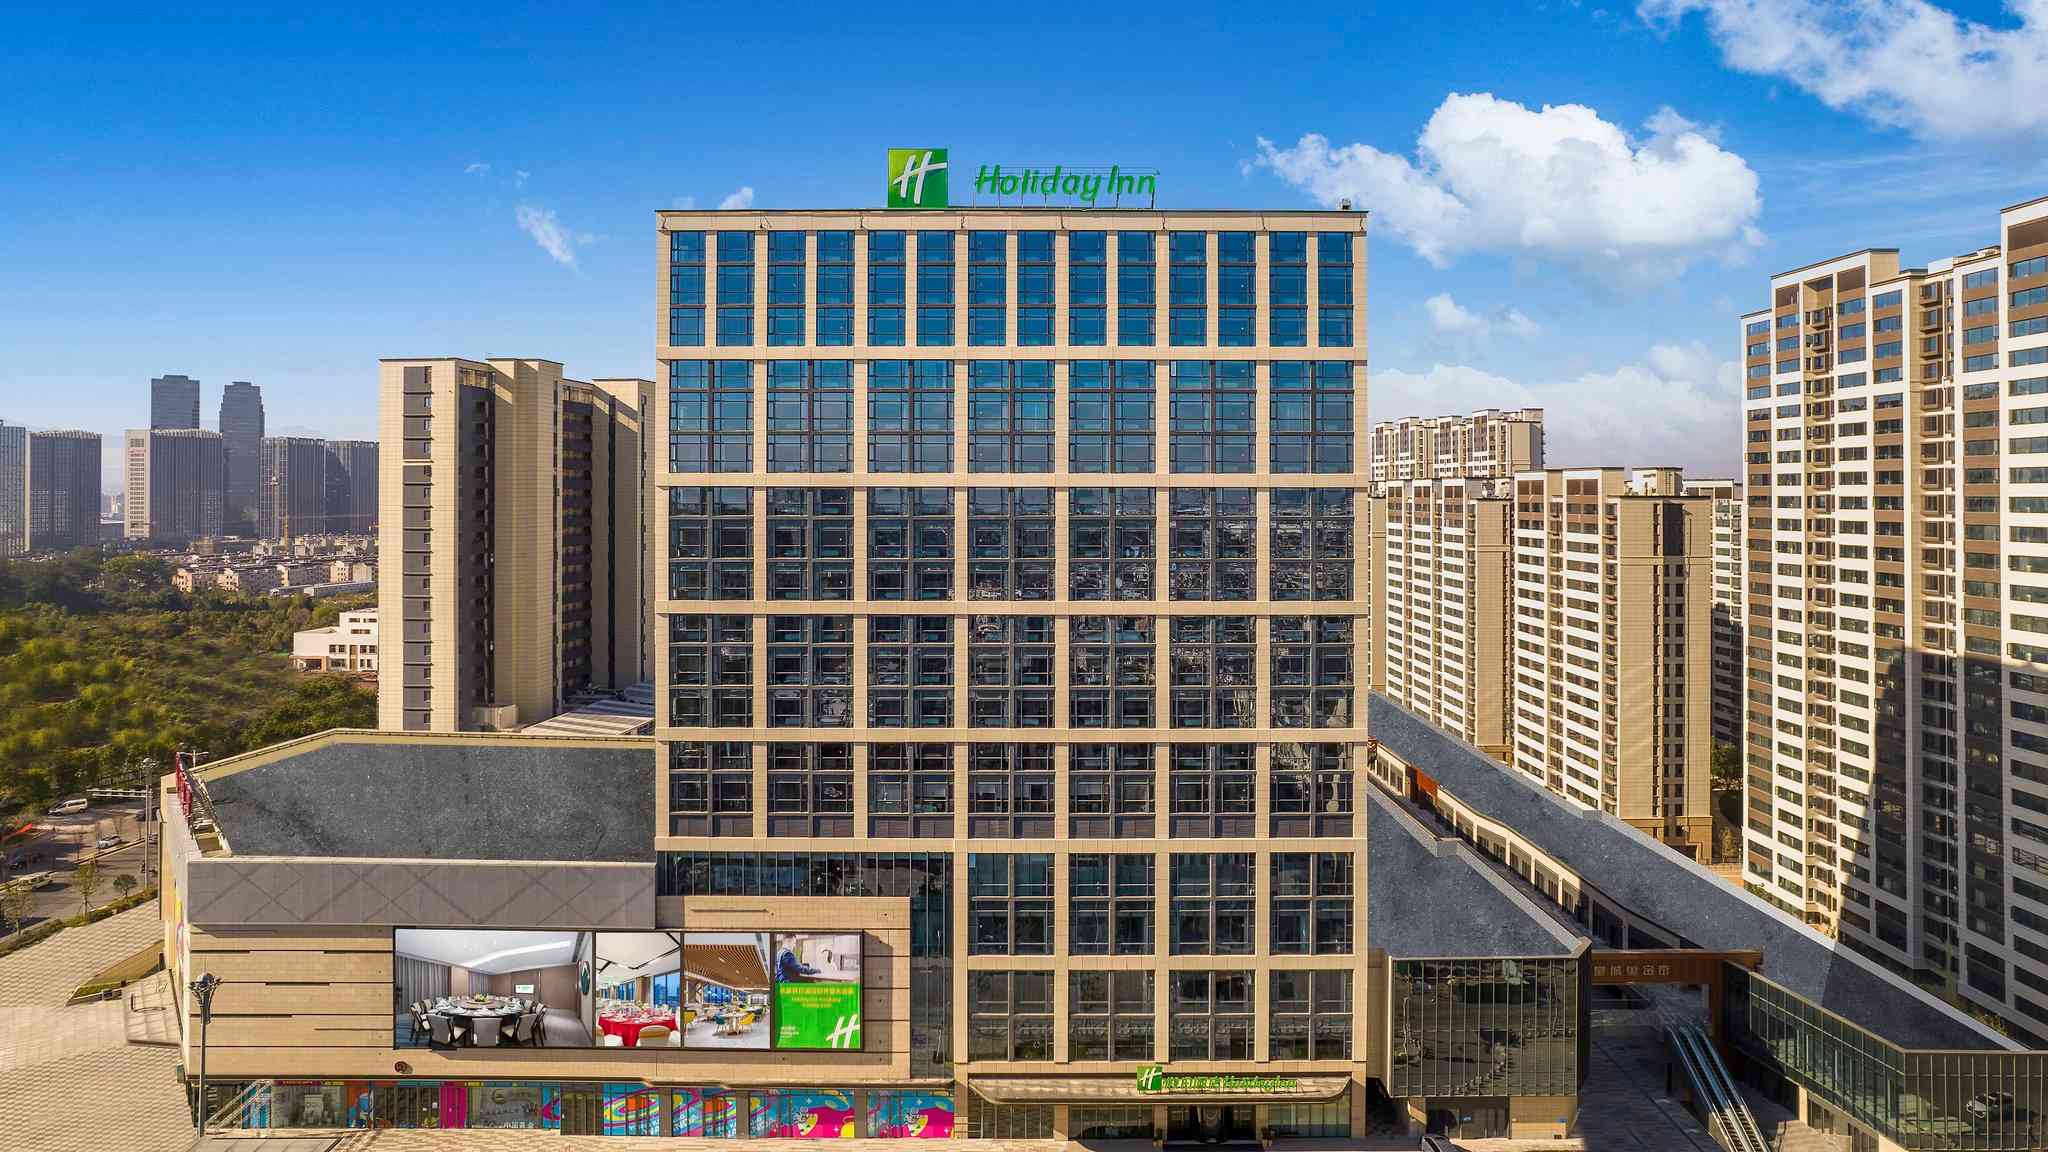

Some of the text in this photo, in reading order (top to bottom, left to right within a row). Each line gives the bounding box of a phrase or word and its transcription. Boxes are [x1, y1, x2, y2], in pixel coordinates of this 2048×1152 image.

[892, 150, 948, 205] H
[974, 164, 1156, 200] Holiday Inn
